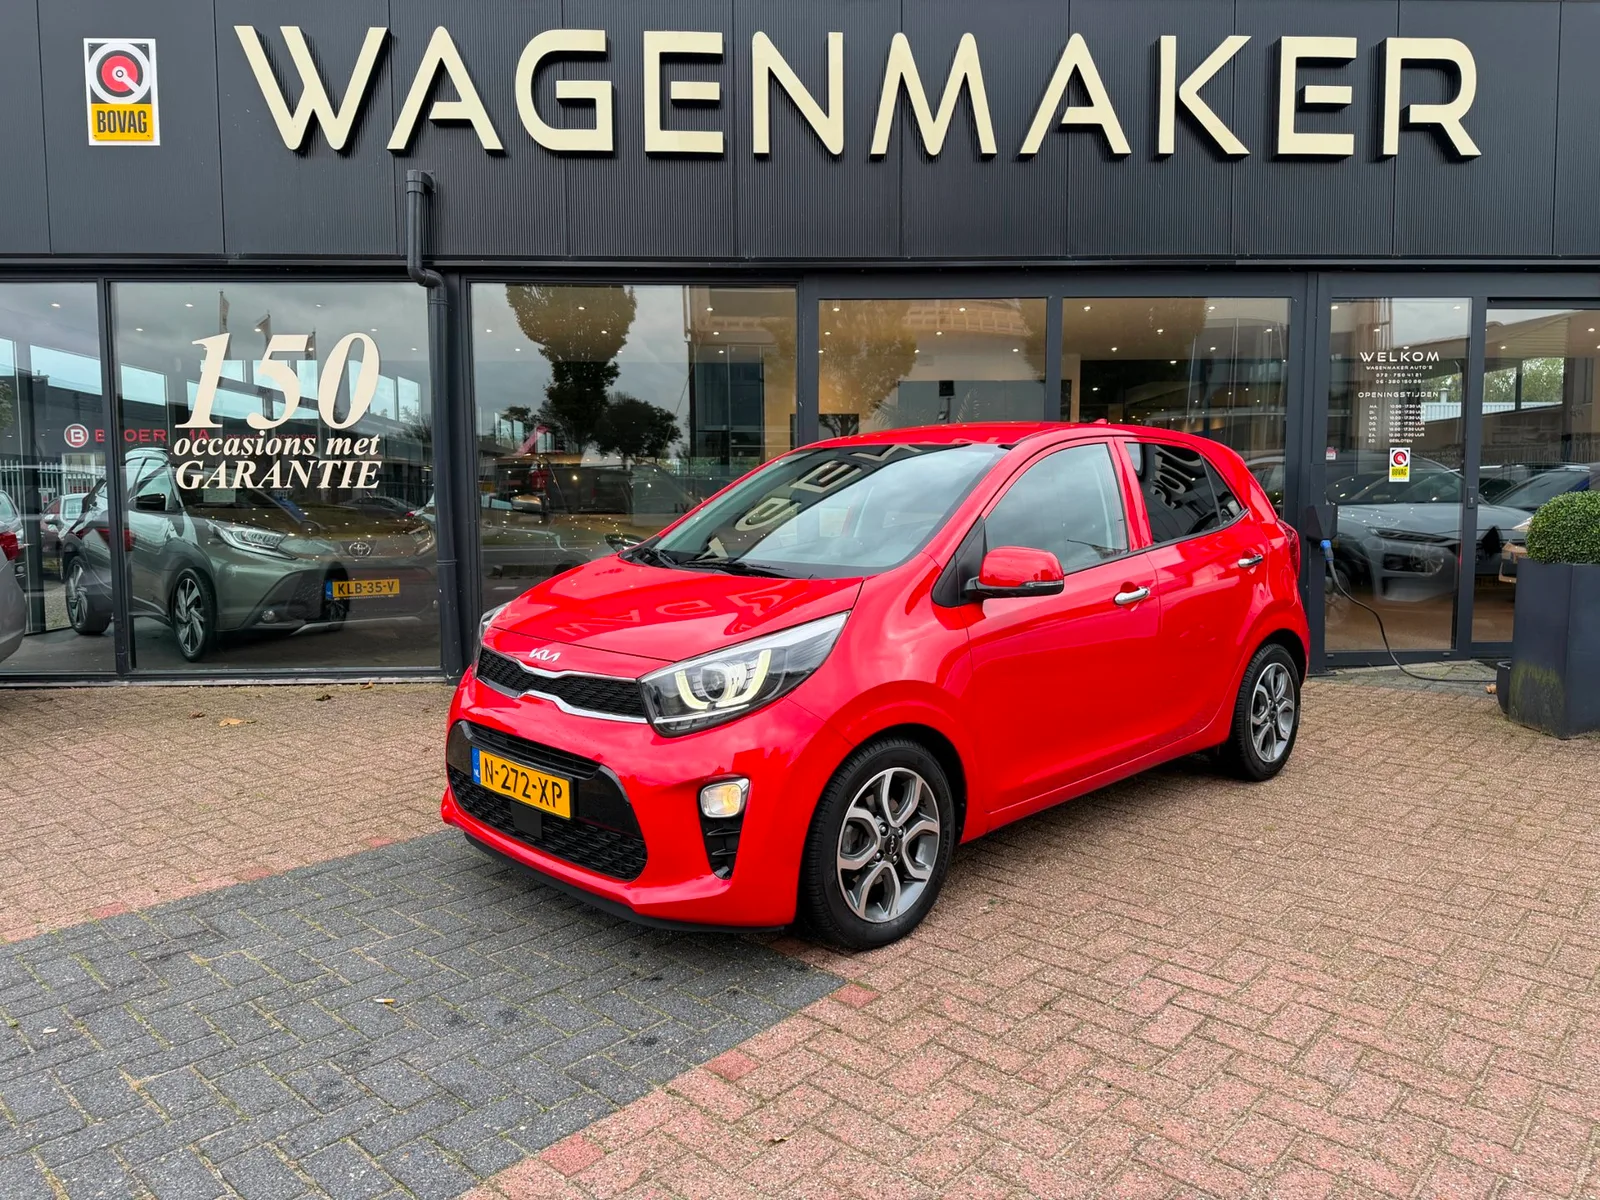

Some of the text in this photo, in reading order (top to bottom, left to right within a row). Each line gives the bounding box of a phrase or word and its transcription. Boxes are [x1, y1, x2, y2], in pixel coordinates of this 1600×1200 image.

[234, 25, 1481, 157] WAGENMAKER
[96, 109, 148, 134] BOVAG
[1360, 351, 1440, 362] WELKOM
[174, 332, 380, 430] 150
[173, 430, 380, 456] occasions met
[175, 460, 382, 490] GARANTIE
[338, 581, 394, 595] KLB-35-V
[529, 648, 561, 662] KIA
[484, 758, 562, 808] N-272-XP
